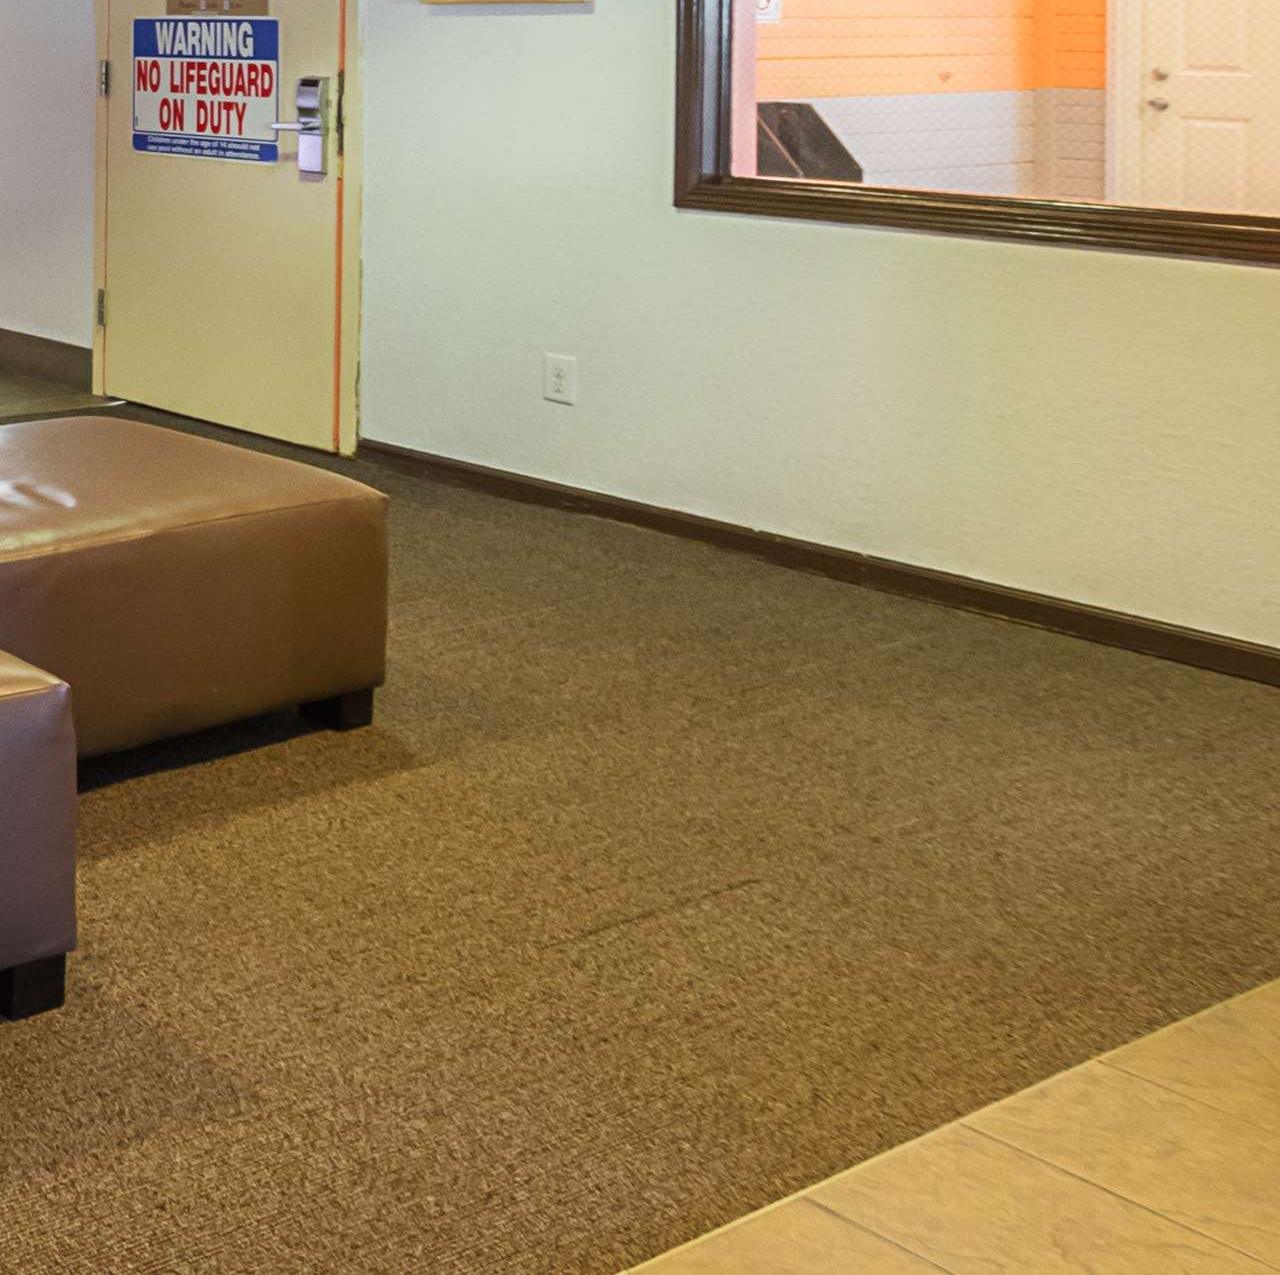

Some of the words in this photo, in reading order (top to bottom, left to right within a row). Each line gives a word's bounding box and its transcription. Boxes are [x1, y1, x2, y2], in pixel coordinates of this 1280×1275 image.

[155, 21, 254, 57] WARNING
[137, 60, 161, 93] NO
[170, 60, 273, 98] LIFEGUARD
[159, 97, 184, 131] ON
[196, 99, 247, 135] DUTY
